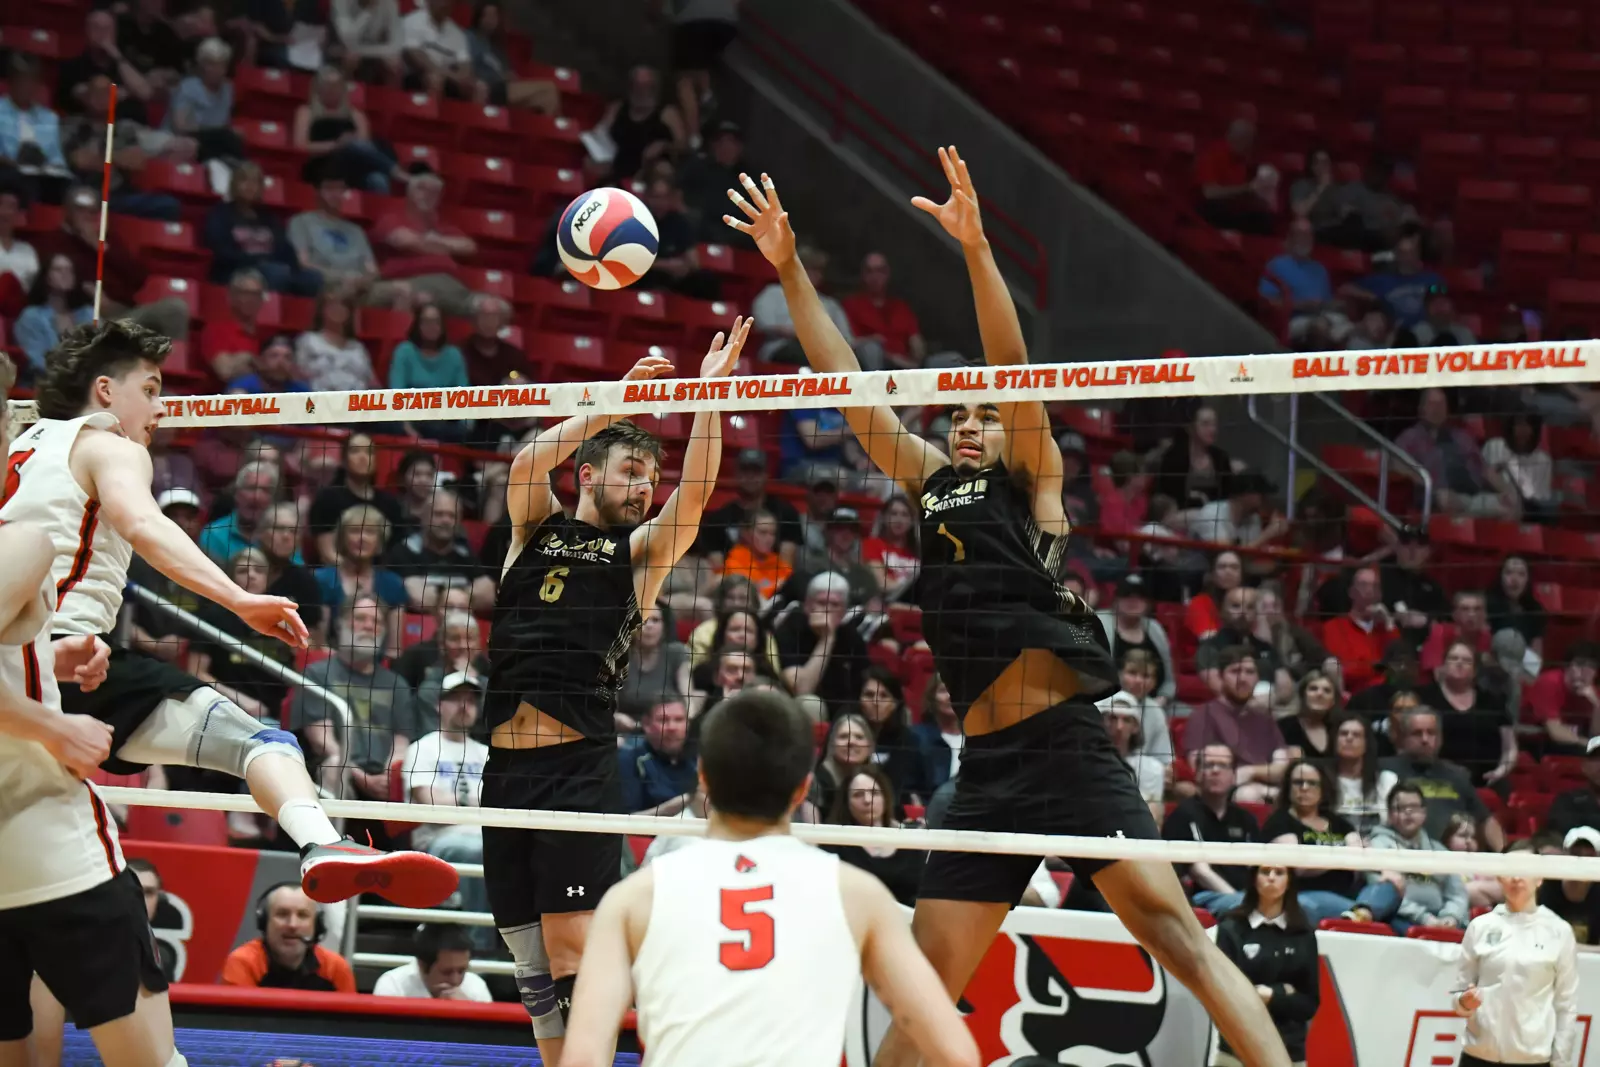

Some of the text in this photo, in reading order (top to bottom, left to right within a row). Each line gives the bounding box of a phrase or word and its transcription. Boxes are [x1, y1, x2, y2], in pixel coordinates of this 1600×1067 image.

[574, 201, 602, 231] NCAA
[937, 363, 1195, 391] BALL STATE VOLLEYBALL
[1293, 347, 1586, 379] BALL STATE VOLLEYBALL
[348, 388, 550, 411] BALL STATE VOLLEYBALL
[623, 376, 851, 402] BALL STATE VOLLEYBALL
[187, 397, 280, 416] VOLLEYBALL
[934, 495, 972, 512] WAYNE
[561, 549, 598, 562] WAYNE
[937, 523, 965, 562] 1
[539, 566, 570, 603] 6
[719, 884, 775, 971] 5
